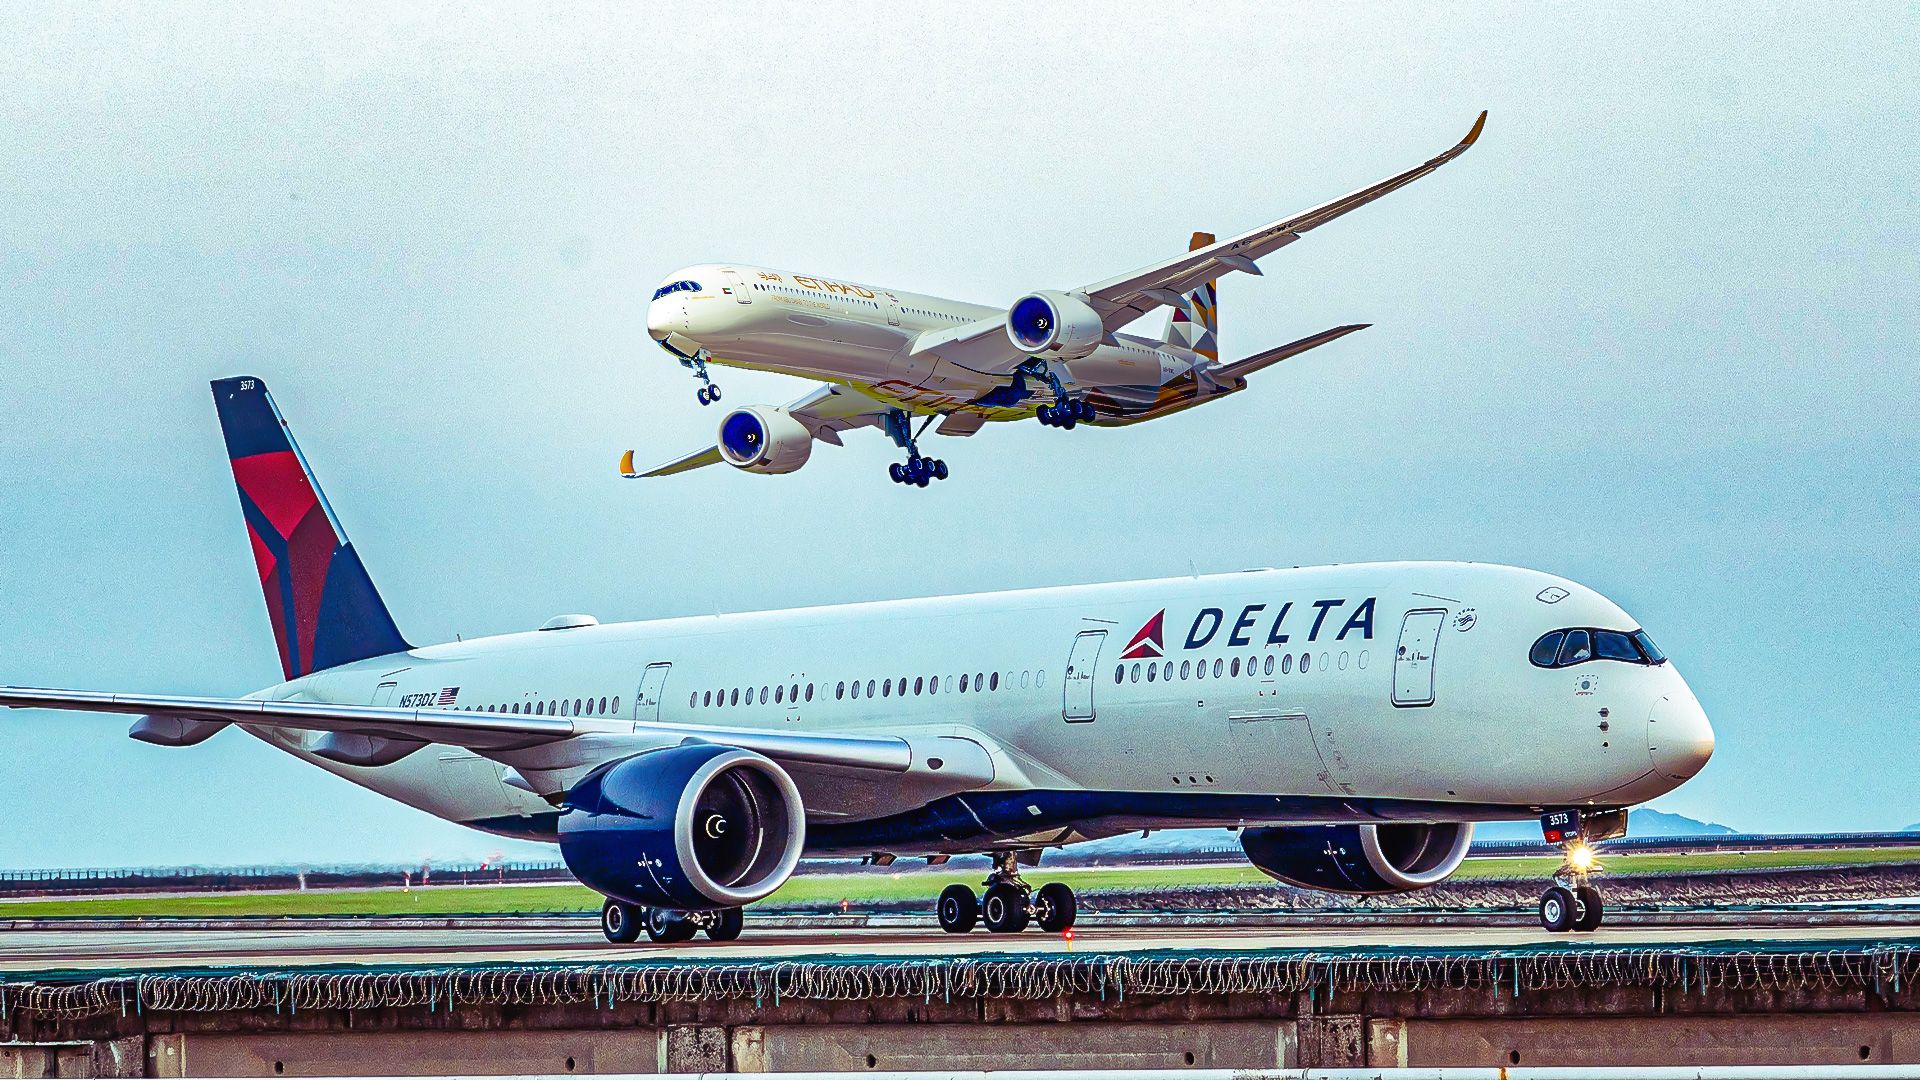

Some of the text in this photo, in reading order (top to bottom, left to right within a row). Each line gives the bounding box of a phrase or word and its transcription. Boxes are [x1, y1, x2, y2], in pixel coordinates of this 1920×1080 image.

[792, 275, 875, 299] ETIHAD
[240, 379, 255, 391] 3573
[1183, 597, 1377, 650] DELTA
[399, 692, 438, 708] N573DZ
[1549, 812, 1569, 826] 3573
